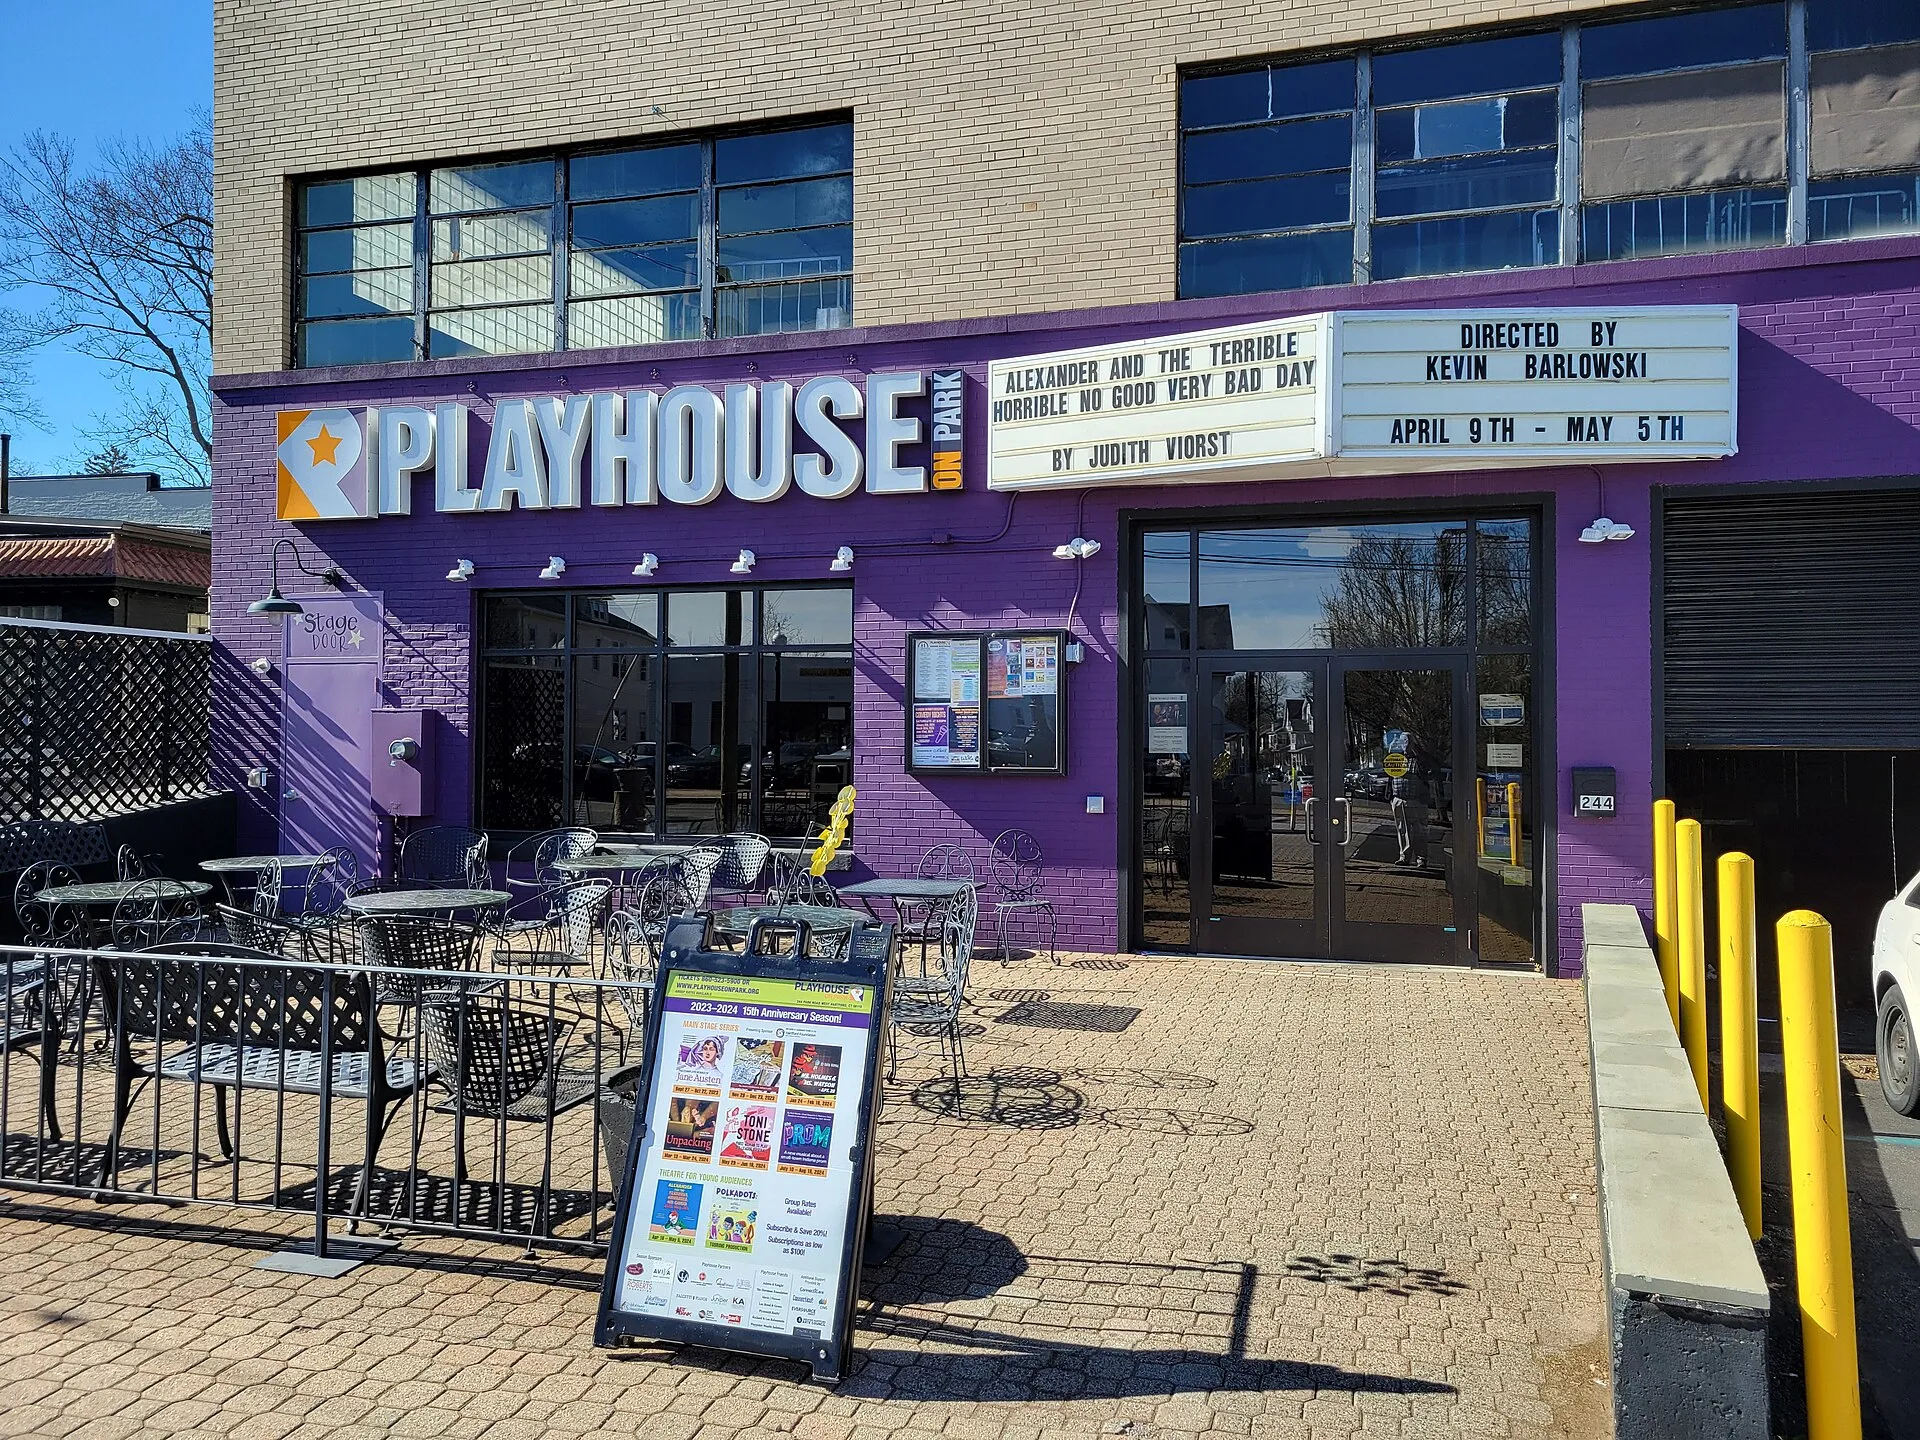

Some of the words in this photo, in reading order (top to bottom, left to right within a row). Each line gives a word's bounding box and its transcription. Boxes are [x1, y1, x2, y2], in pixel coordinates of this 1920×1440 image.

[1461, 322, 1559, 349] DIRECTED
[1591, 321, 1617, 347] BY
[1006, 360, 1099, 394] ALEXANDER
[1110, 353, 1144, 380] AND
[1158, 347, 1191, 373] THE
[1209, 332, 1297, 367] TERRIBLE
[1426, 354, 1487, 381] KEVIN
[1525, 352, 1647, 379] BARLOWSKI
[993, 392, 1068, 423] HORRIBLE
[1080, 387, 1102, 412] NO
[1112, 381, 1156, 409] GOOD
[1167, 374, 1212, 402] VERY
[1225, 367, 1262, 395] BAD
[1276, 360, 1315, 388] DAY
[933, 370, 962, 442] PARK
[1390, 418, 1449, 444] APRIL
[1567, 416, 1613, 442] MAY
[379, 370, 930, 517] PLAYHOUSE
[1052, 447, 1073, 472] BY
[1089, 440, 1149, 468] JUDITH
[1166, 431, 1230, 460] VIORST
[933, 451, 962, 489] ON
[304, 612, 358, 636] Stage
[312, 632, 349, 653] DOOR
[1581, 796, 1613, 810] 244
[676, 982, 760, 995] WWW.PLAYHOUSEONPARK.ORG
[794, 982, 849, 994] PLAYHOUSE
[742, 1005, 759, 1016] 15th
[760, 1007, 809, 1023] Anniversary
[809, 1011, 842, 1024] Season!
[682, 1020, 700, 1029] MAIN
[700, 1021, 718, 1030] STAGE
[718, 1023, 740, 1032] SERIES
[676, 1072, 693, 1082] Jane
[694, 1074, 721, 1084] Austen
[743, 1114, 767, 1129] TONI
[666, 1134, 712, 1150] Unpacking
[736, 1128, 771, 1142] STONE
[783, 1123, 831, 1148] PROM
[659, 1168, 684, 1179] THEATRE
[685, 1172, 697, 1180] FOR
[699, 1173, 719, 1183] YOUNG
[720, 1175, 753, 1187] AUDIENCES
[716, 1187, 759, 1200] POLKADOTS:
[784, 1197, 800, 1207] Group
[801, 1199, 816, 1208] Rates
[786, 1207, 812, 1217] Available!
[766, 1223, 793, 1233] Subscribe
[794, 1226, 798, 1234] &
[799, 1227, 812, 1236] Save
[813, 1229, 828, 1238] 20%!
[709, 1241, 725, 1249] TOURING
[726, 1243, 748, 1251] PRODUCTION
[768, 1235, 804, 1247] Subscriptions
[813, 1241, 823, 1249] low
[790, 1247, 805, 1256] $100!
[627, 1280, 653, 1291] ROBERTS
